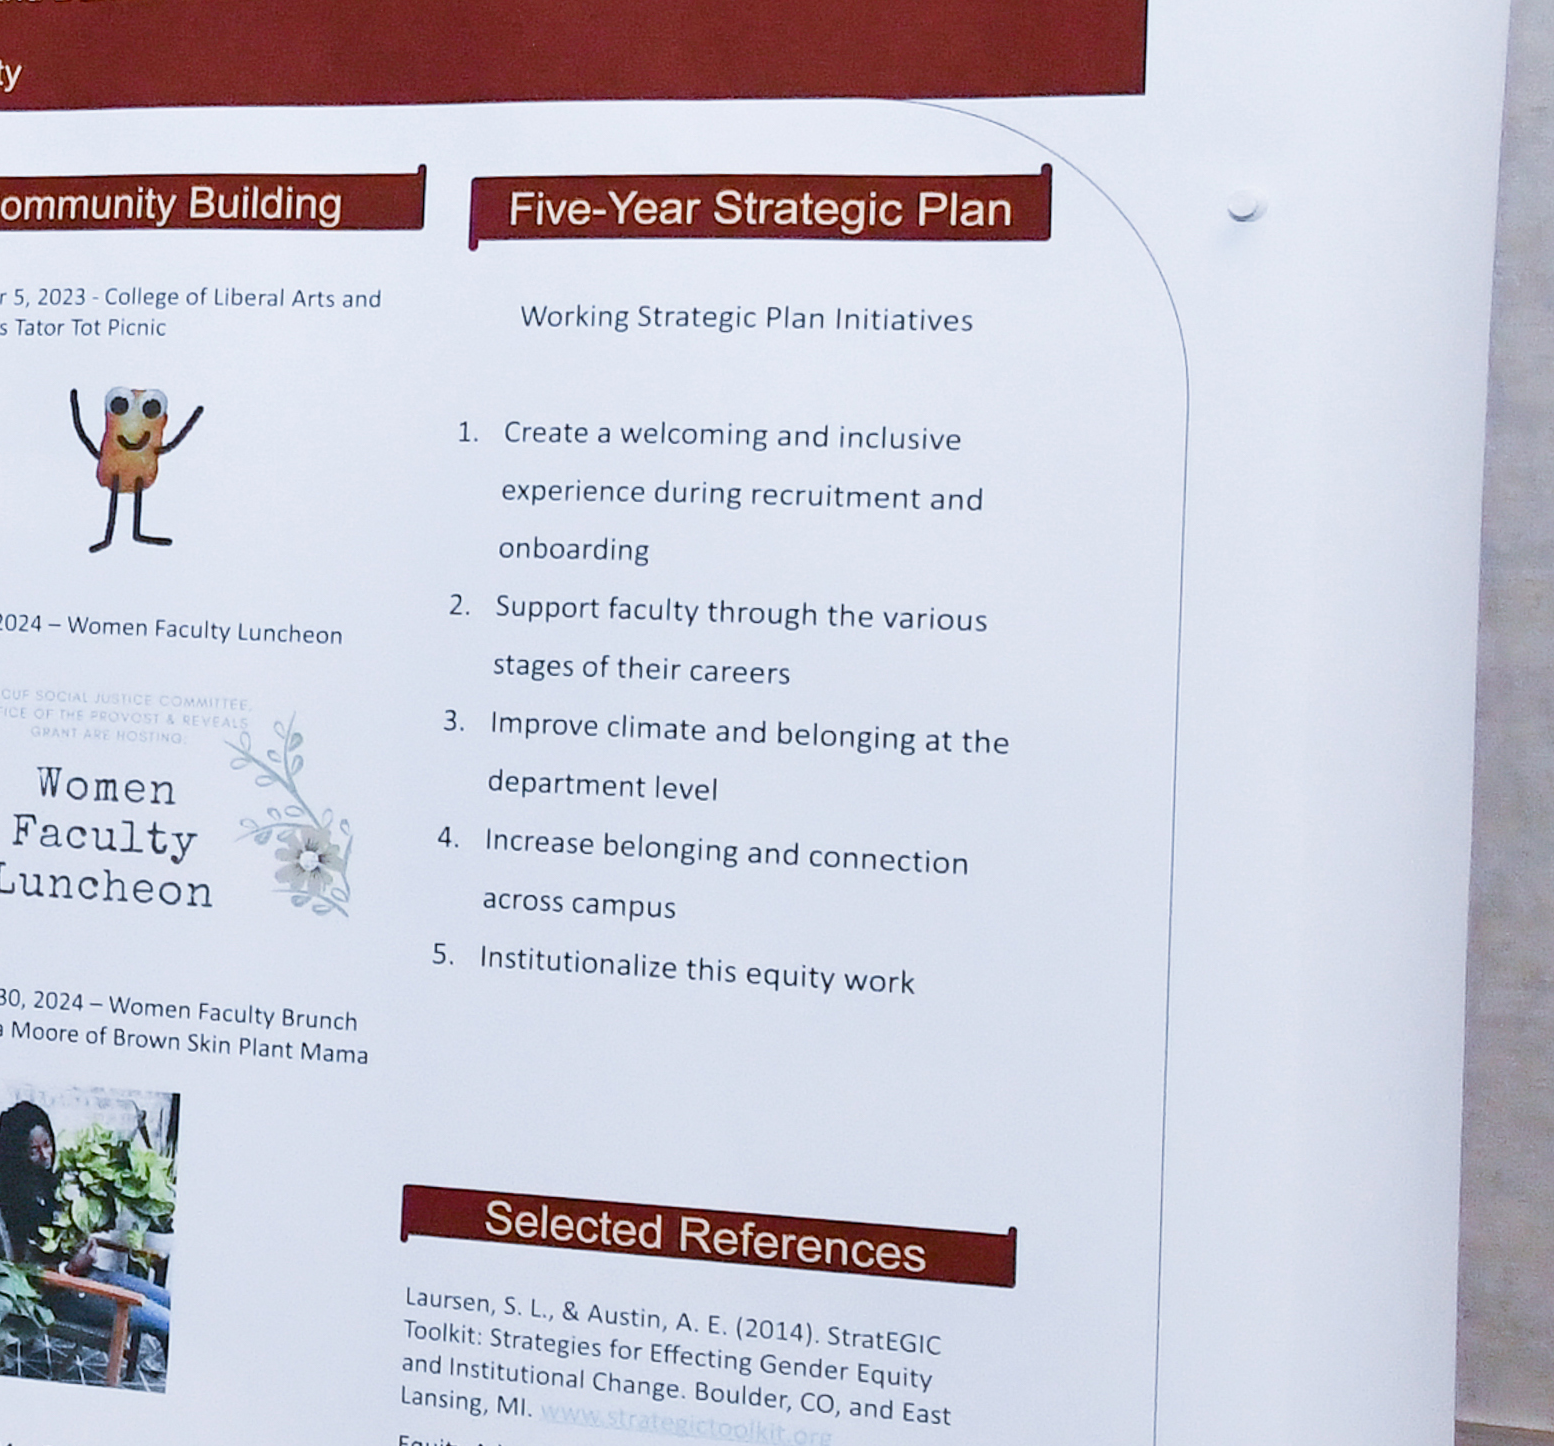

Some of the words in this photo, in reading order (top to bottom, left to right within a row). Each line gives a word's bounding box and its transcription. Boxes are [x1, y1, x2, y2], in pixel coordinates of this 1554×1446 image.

[190, 186, 341, 223] Building
[511, 191, 701, 225] Five-Year
[714, 190, 902, 229] Strategic
[919, 192, 1011, 226] Plan
[15, 319, 65, 336] Tator
[71, 319, 101, 336] Tot
[108, 318, 166, 336] Picnic
[521, 304, 629, 333] Working
[638, 305, 756, 333] Strategic
[767, 306, 824, 329] Plan
[836, 308, 973, 332] Initiatives
[459, 421, 478, 442] 1.
[505, 421, 588, 443] Create
[598, 427, 610, 443] a
[620, 421, 768, 451] welcoming
[778, 425, 828, 448] and
[840, 426, 961, 451] inclusive
[502, 479, 645, 506] experience
[655, 480, 741, 510] during
[752, 485, 920, 509] recruitment
[931, 488, 983, 511] and
[499, 536, 649, 566] onboarding
[68, 616, 147, 636] Women
[156, 619, 231, 644] Faculty
[238, 623, 342, 644] Luncheon
[37, 767, 175, 805] Women
[12, 814, 198, 865] Faculty
[433, 943, 453, 965] 5.
[481, 945, 677, 979] Institutionalize
[687, 957, 736, 983] this
[746, 965, 835, 994] equity
[844, 970, 915, 994] work
[485, 1201, 662, 1248] Selected
[680, 1217, 926, 1271] References
